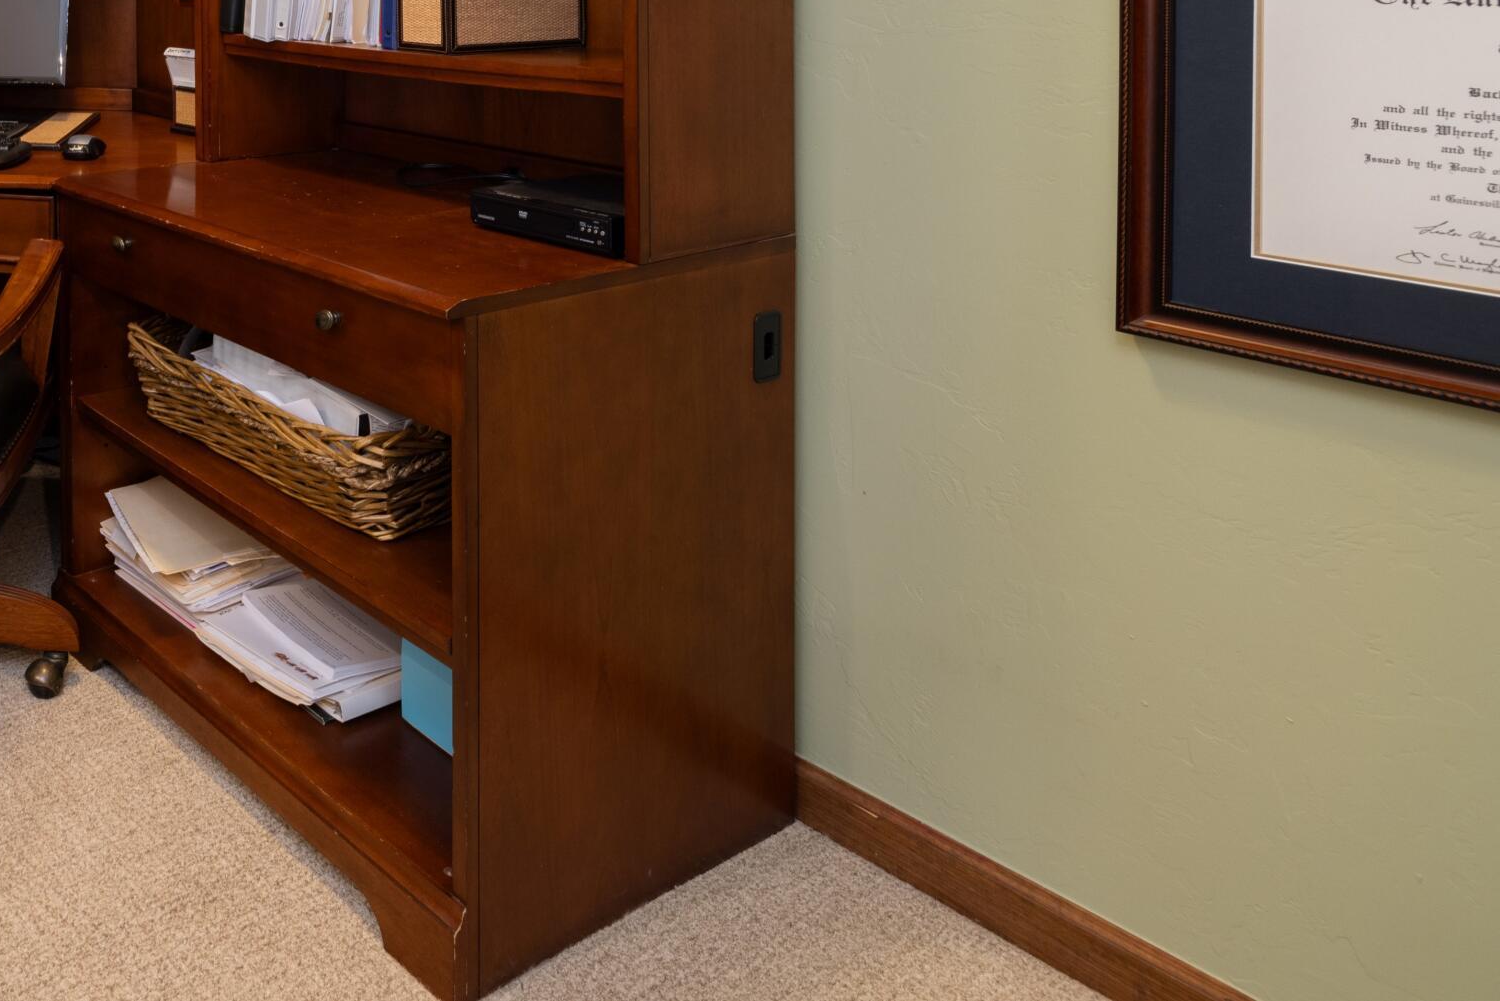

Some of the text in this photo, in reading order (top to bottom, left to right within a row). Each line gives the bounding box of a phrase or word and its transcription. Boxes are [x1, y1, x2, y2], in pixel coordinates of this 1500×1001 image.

[1468, 87, 1500, 99] Bac
[1383, 105, 1406, 114] and
[1413, 106, 1429, 116] all
[1437, 107, 1456, 120] the
[1350, 117, 1499, 141] In Witness Whereof,
[1441, 145, 1493, 160] and the
[1364, 153, 1401, 165] Issued
[1407, 158, 1421, 170] by
[1426, 160, 1442, 171] the
[1449, 162, 1486, 174] Board
[1486, 182, 1500, 194] T
[1430, 194, 1441, 202] at
